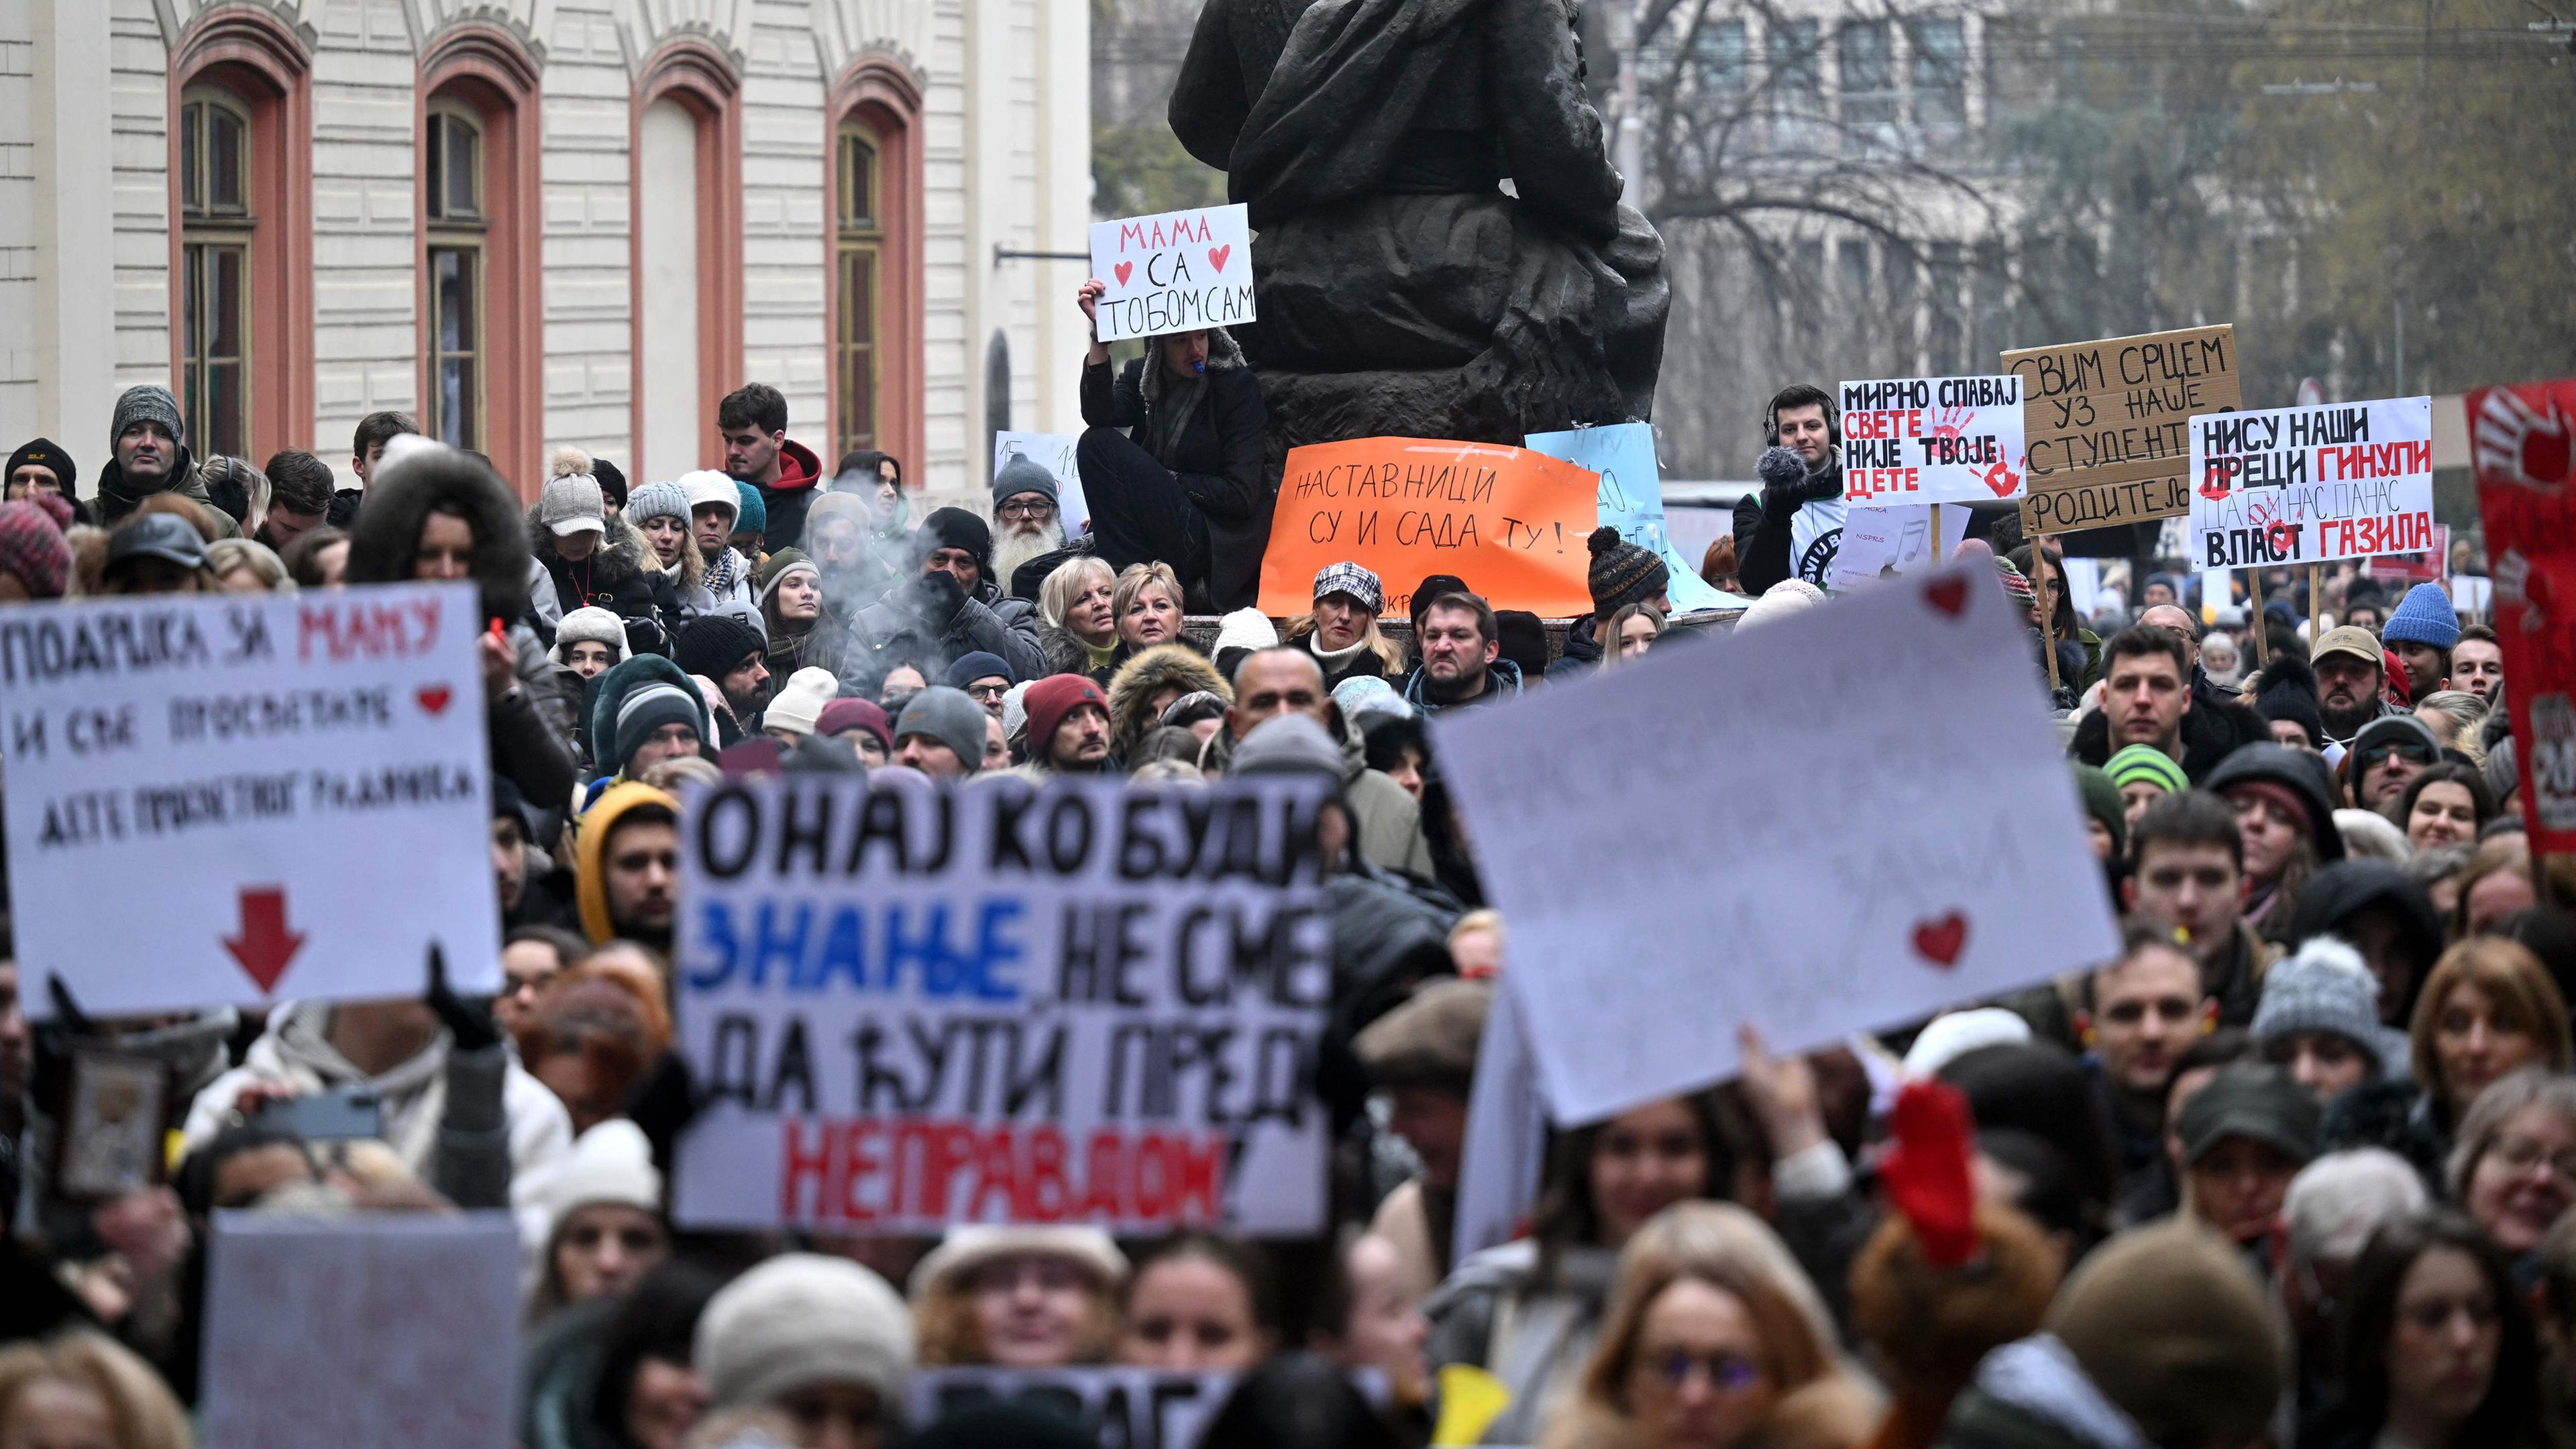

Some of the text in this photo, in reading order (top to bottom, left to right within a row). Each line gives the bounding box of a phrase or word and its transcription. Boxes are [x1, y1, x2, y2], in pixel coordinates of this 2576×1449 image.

[1120, 214, 1213, 254] МАМА
[1147, 252, 1191, 287] СА
[2010, 336, 2226, 401] СВИМ СРЦЕМ
[1845, 377, 2017, 411] МИРНО СПАВАЈ
[2052, 382, 2206, 429] УЗ НАШЕ
[1844, 409, 1922, 440] СВЕТЕ
[2027, 421, 2187, 475] СТУДЕНТ
[2203, 407, 2369, 455] НИСУ НАШИ
[1845, 435, 1997, 469] НИЈЕ ТВОЈЕ
[2203, 439, 2432, 493] ПРЕЦИ ГИНУЛИ
[1294, 462, 1497, 504] НАСТАВНИЦИ
[1845, 467, 1919, 500] ДЕТЕ
[2027, 477, 2190, 530] РОДИТЕЉ
[2200, 479, 2400, 535] ДА БИ НАС ДАНАС
[1309, 510, 1343, 544] СУ
[1358, 511, 1379, 546] И
[1395, 511, 1479, 549] САДА
[1856, 533, 1885, 543] NSPRS
[2206, 511, 2432, 568] ВЛАСТ ГАЗИЛА
[1804, 555, 1820, 584] SVI
[227, 606, 274, 663] ЗА
[297, 599, 443, 661] МАМУ
[12, 710, 47, 760] И
[698, 785, 1323, 889] ОНАЈ КО БУДИ
[1059, 900, 1157, 1006] НЕ
[1177, 902, 1332, 1008] СМЕ
[704, 1012, 1305, 1128] ДА ЋУТИ ПРЕД
